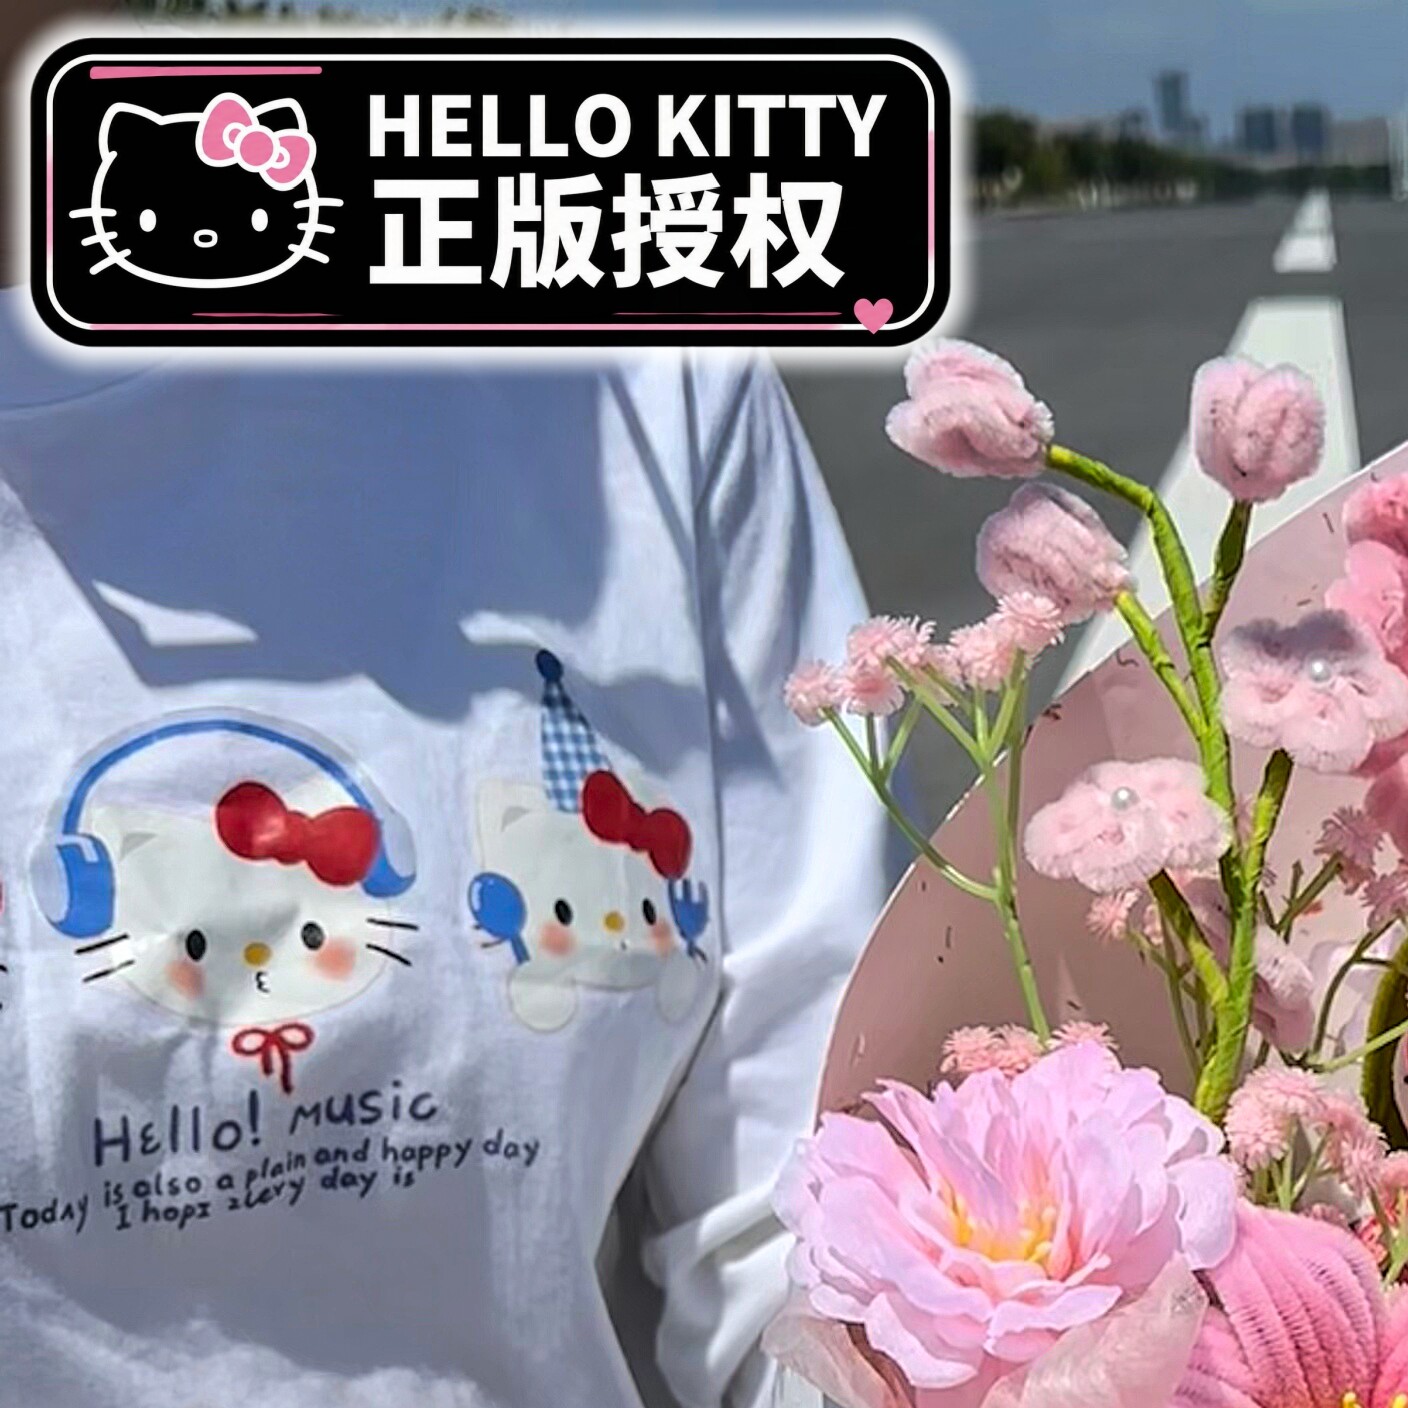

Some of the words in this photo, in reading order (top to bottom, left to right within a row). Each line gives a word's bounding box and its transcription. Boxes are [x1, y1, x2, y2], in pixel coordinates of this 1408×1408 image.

[94, 1089, 260, 1167] Hello!
[104, 1180, 123, 1207] is
[133, 1173, 202, 1198] also
[216, 1174, 235, 1190] a
[245, 1150, 306, 1190] plain
[314, 1138, 371, 1166] and
[382, 1136, 473, 1171] happy
[483, 1128, 540, 1167] day
[116, 1204, 132, 1230] I
[320, 1166, 378, 1198] day
[393, 1166, 415, 1188] is
